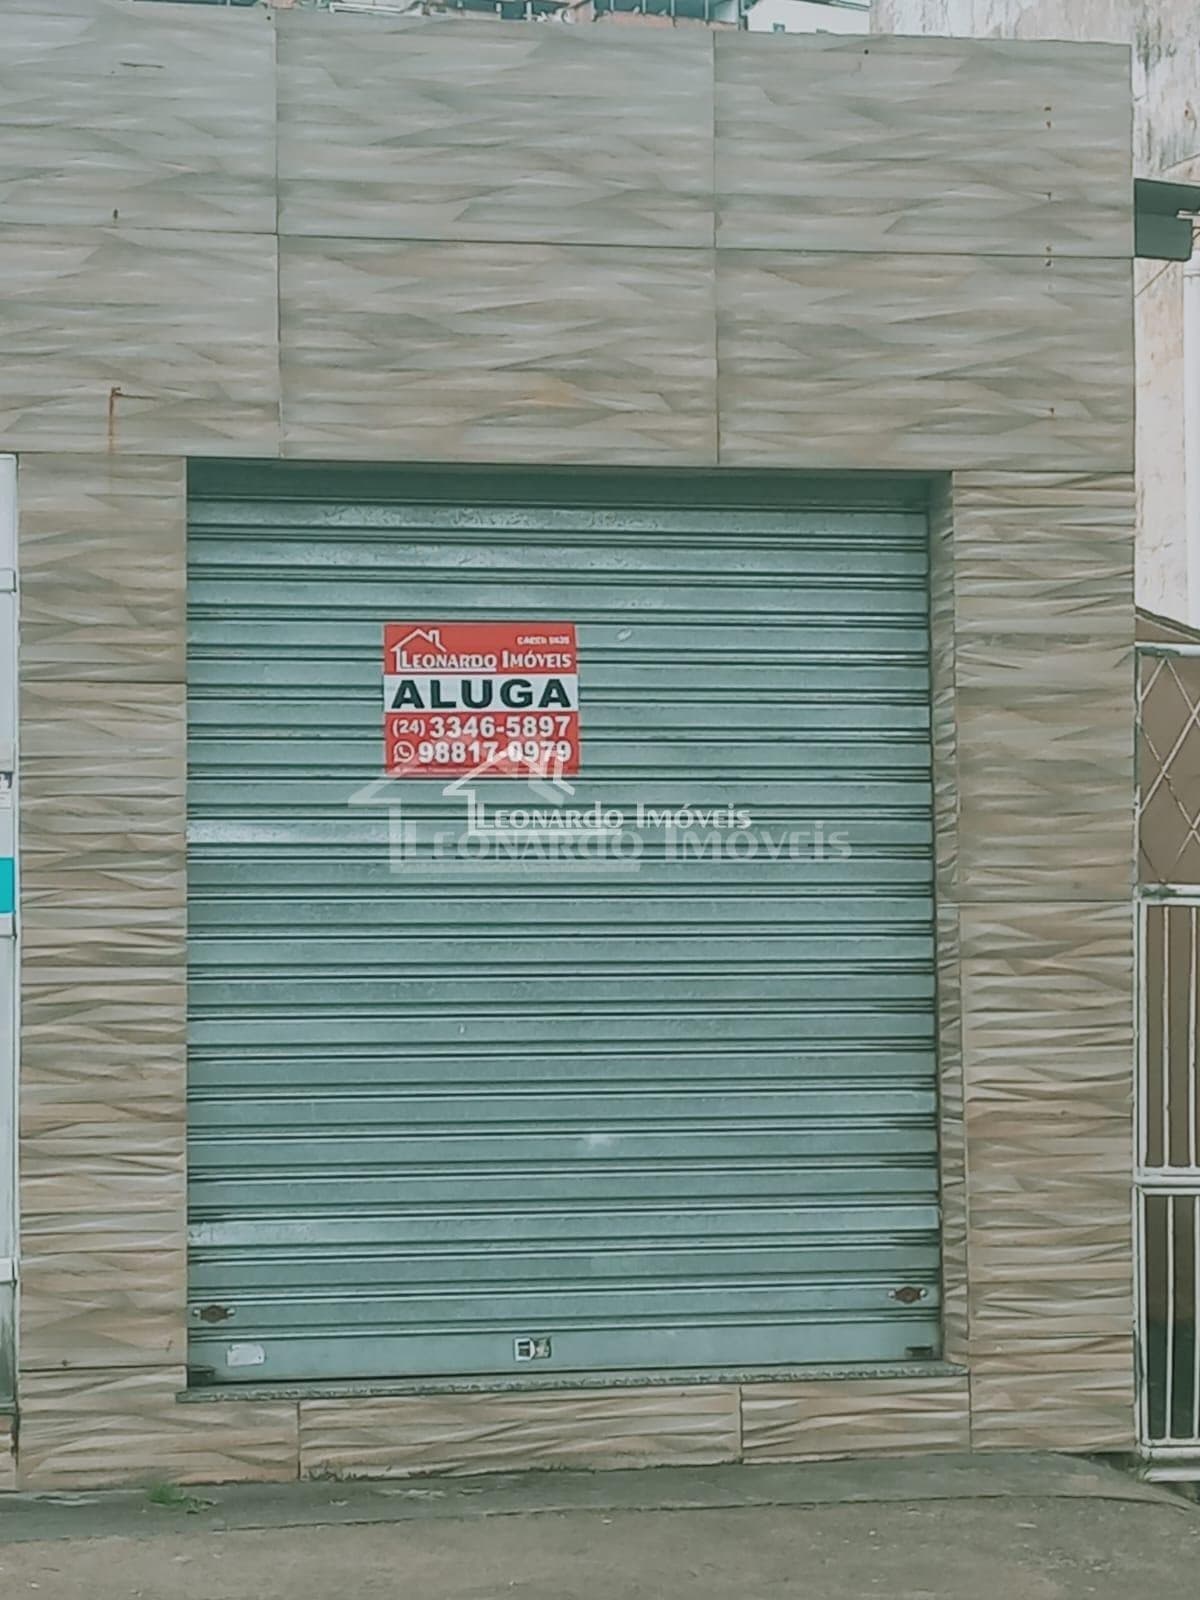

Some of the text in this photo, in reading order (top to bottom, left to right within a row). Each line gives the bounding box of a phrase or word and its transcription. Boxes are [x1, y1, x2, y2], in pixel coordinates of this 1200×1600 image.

[401, 650, 572, 669] LEONARDO IMÓVEIS
[391, 678, 572, 709] ALUGA
[393, 716, 571, 738] (24) 3346-5897
